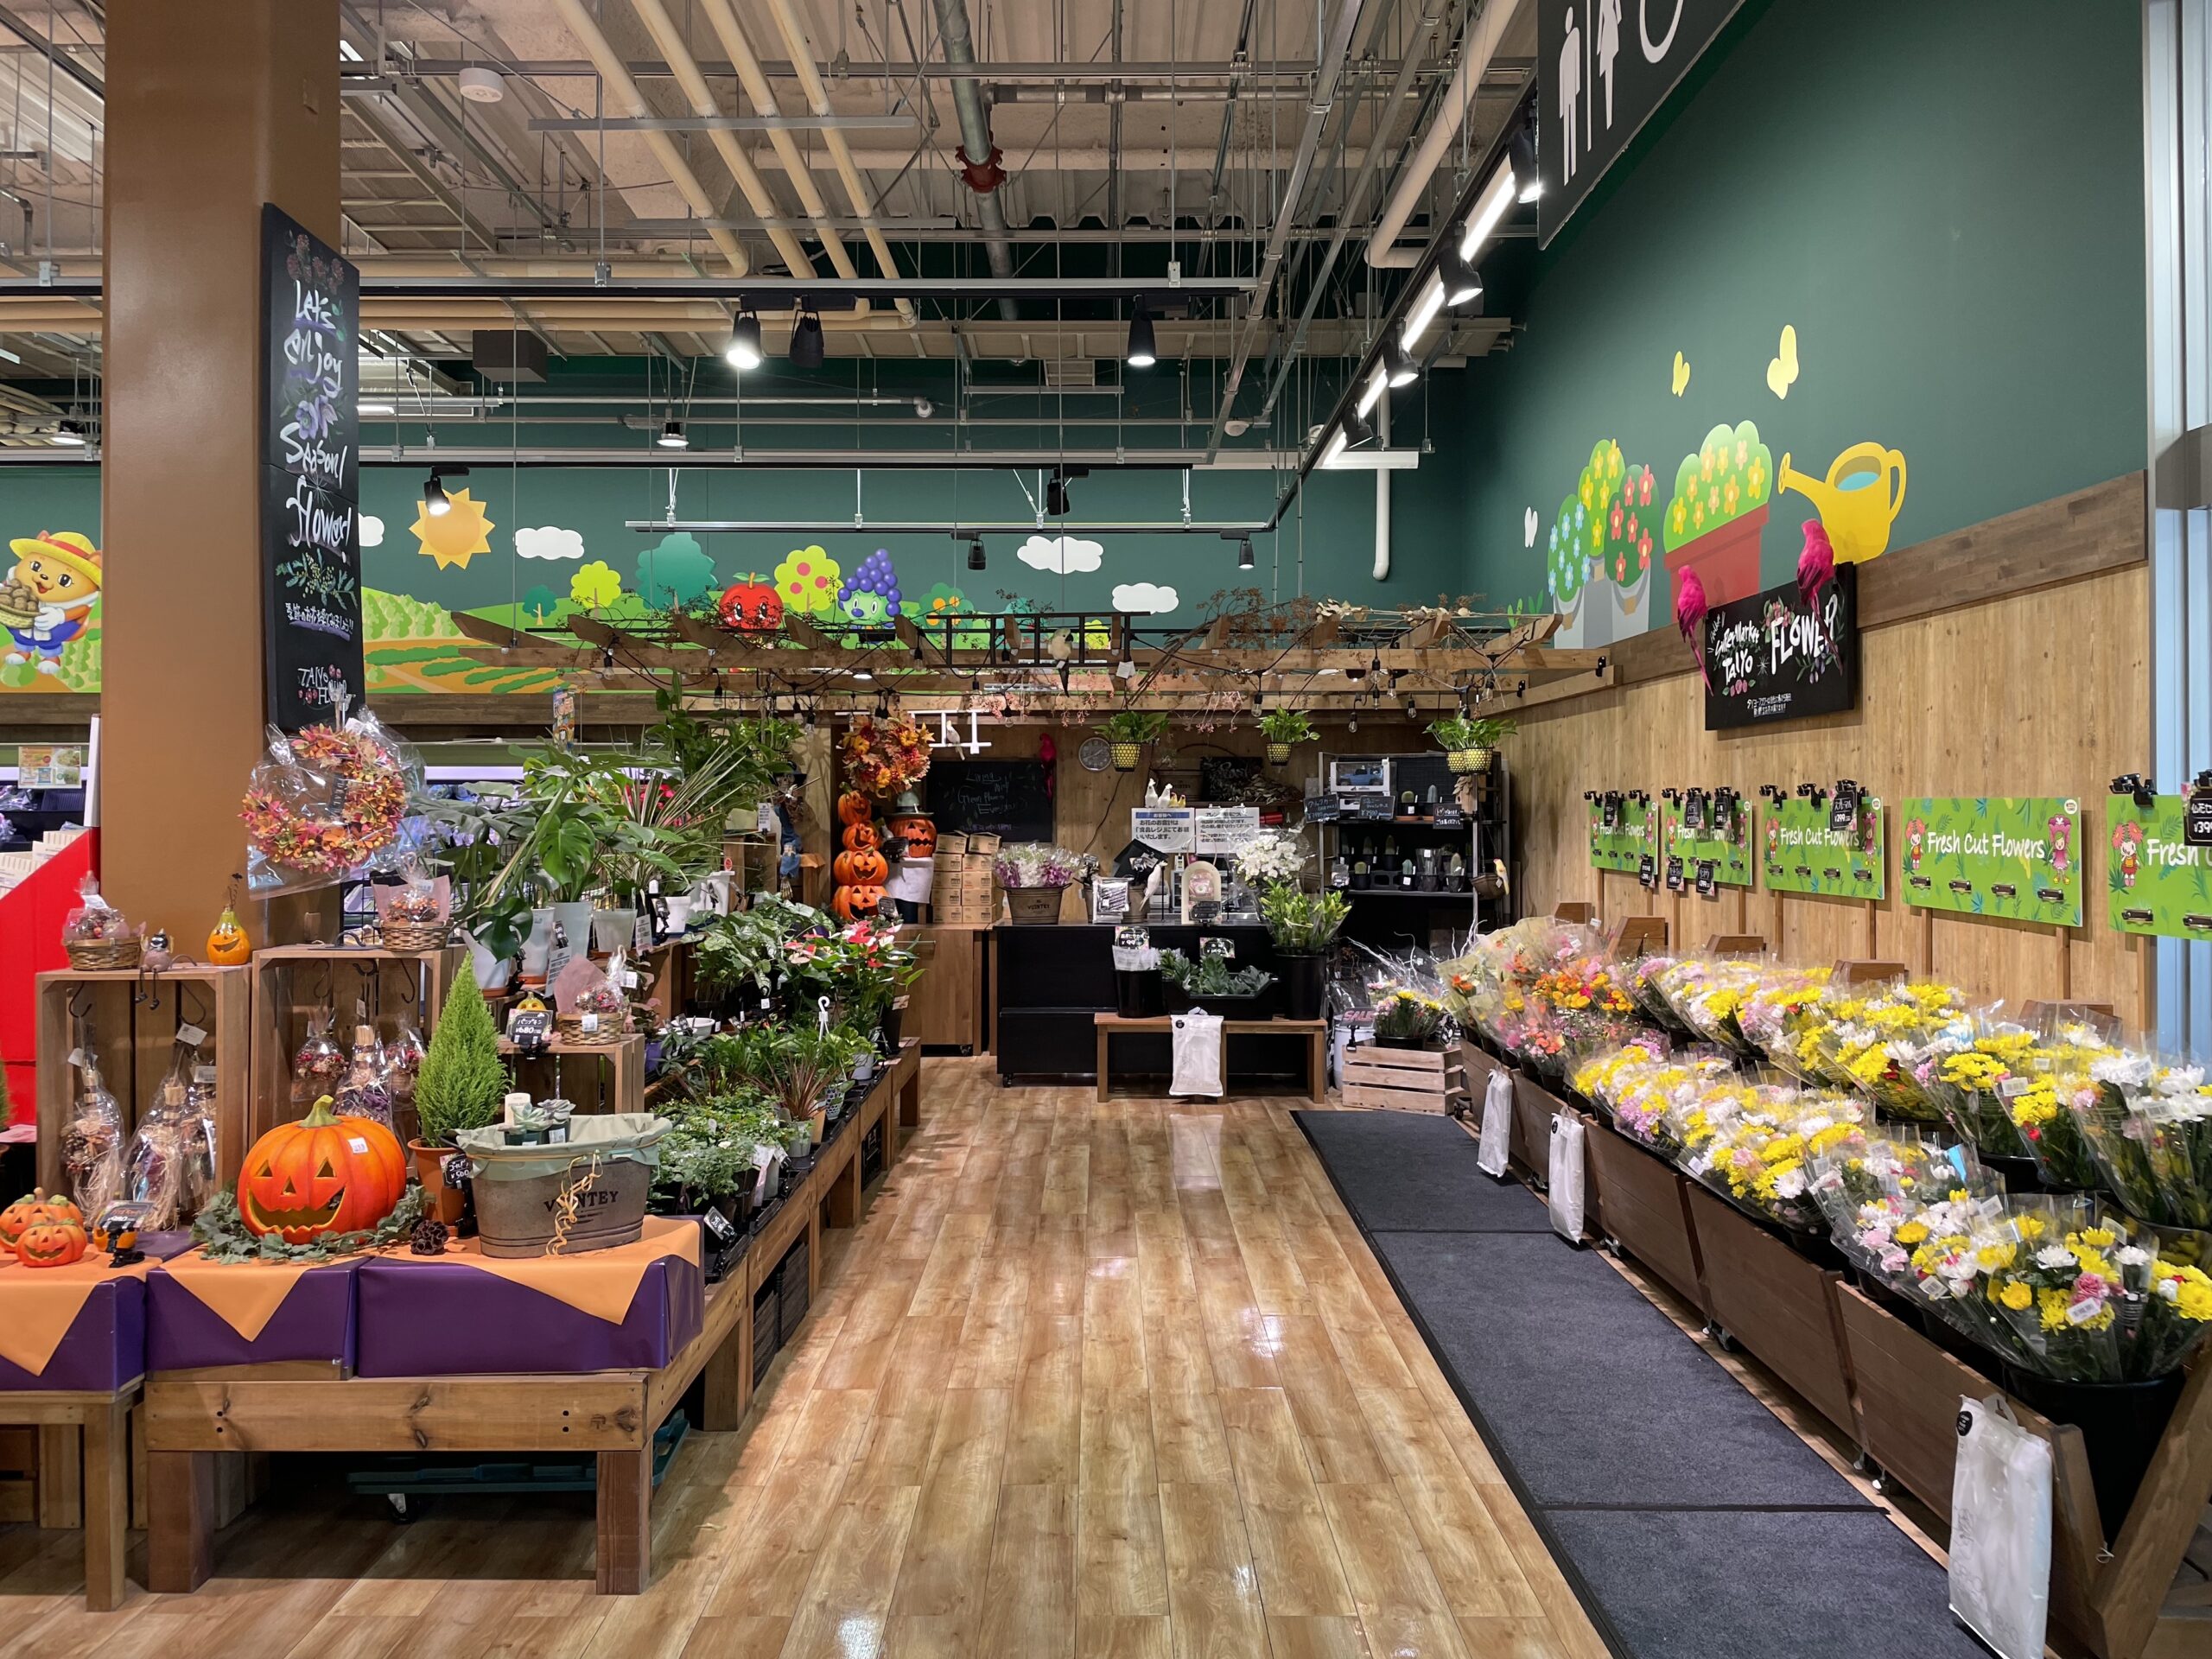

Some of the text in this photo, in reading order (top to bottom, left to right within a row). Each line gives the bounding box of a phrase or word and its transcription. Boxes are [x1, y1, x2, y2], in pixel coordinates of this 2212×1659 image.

[283, 328, 343, 399] enjoy
[1625, 822, 1645, 836] Flowers
[1678, 824, 1694, 839] Fresh
[2194, 821, 2212, 833] ¥39
[1780, 826, 1859, 848] Fresh Cut Flowers
[1928, 830, 2045, 859] Fresh Cut Flowers
[1344, 1010, 1375, 1021] SALE
[543, 1189, 620, 1212] VNTEY
